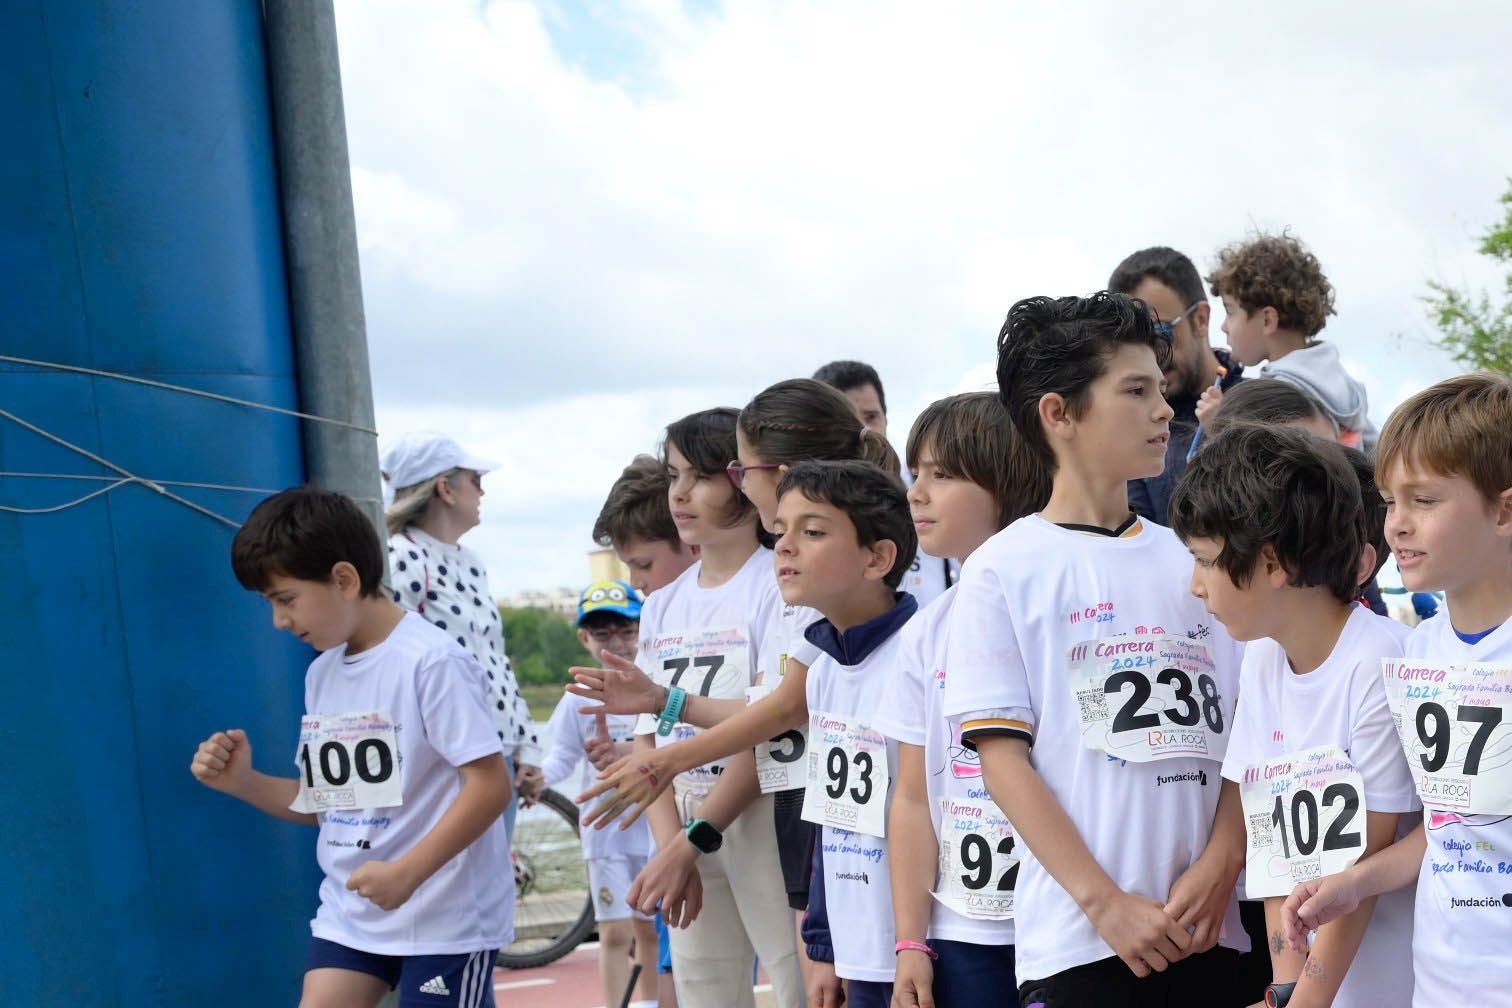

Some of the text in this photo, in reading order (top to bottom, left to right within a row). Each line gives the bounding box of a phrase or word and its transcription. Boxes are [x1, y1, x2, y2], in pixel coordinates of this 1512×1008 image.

[1071, 641, 1155, 662] III Carrera
[1111, 656, 1158, 671] 2024
[1397, 663, 1447, 682] Carrera
[1104, 668, 1224, 734] 238
[1406, 685, 1443, 700] 2024
[819, 715, 847, 732] Carrera
[1415, 701, 1503, 776] 97
[301, 738, 393, 788] 100
[825, 746, 873, 805] 93
[1157, 771, 1200, 786] fundación
[1244, 761, 1293, 784] III Carrera
[1271, 779, 1292, 796] 2024
[1442, 784, 1469, 798] ROCA
[949, 802, 983, 818] Carrera
[954, 819, 983, 832] 2024
[1272, 782, 1362, 860] 102
[960, 834, 1020, 891] 92
[1457, 860, 1493, 874] Familia
[1450, 896, 1501, 909] fundación
